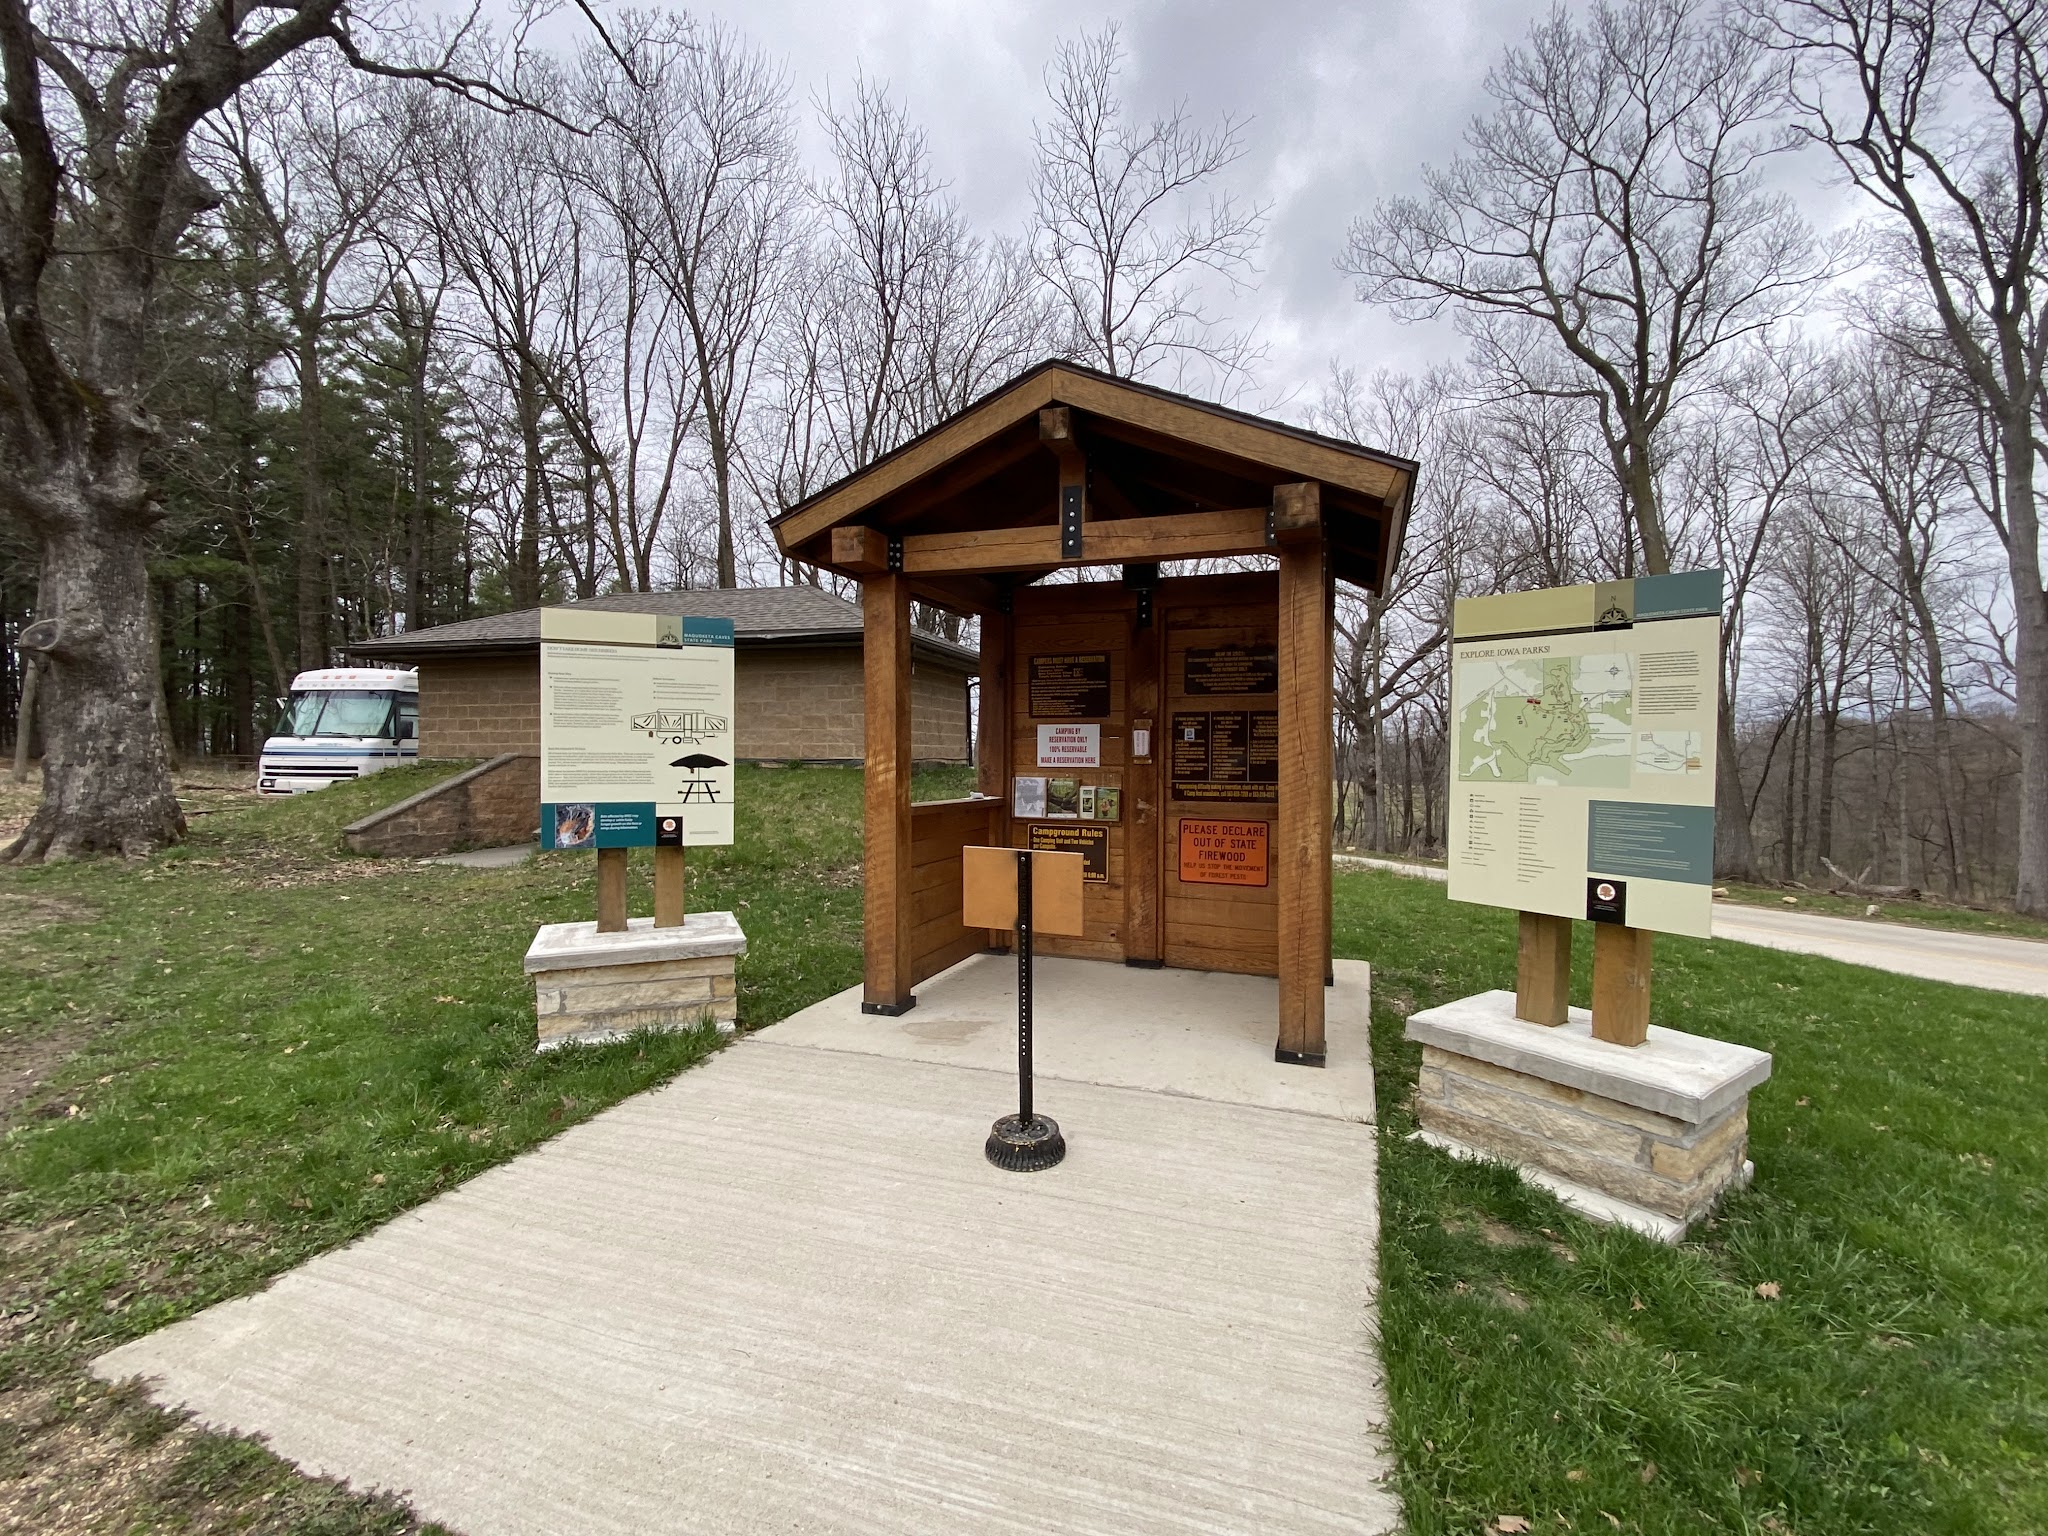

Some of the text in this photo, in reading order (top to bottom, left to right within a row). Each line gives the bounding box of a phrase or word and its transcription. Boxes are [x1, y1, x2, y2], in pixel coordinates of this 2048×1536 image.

[1460, 646, 1550, 659] EXPLORE IOWA PARKS!
[1033, 827, 1103, 837] Campground Rules
[1183, 825, 1265, 837] PLEASE DECLARE
[1193, 838, 1257, 849] OUT OF STATE
[1199, 850, 1245, 862] FIREWOOD
